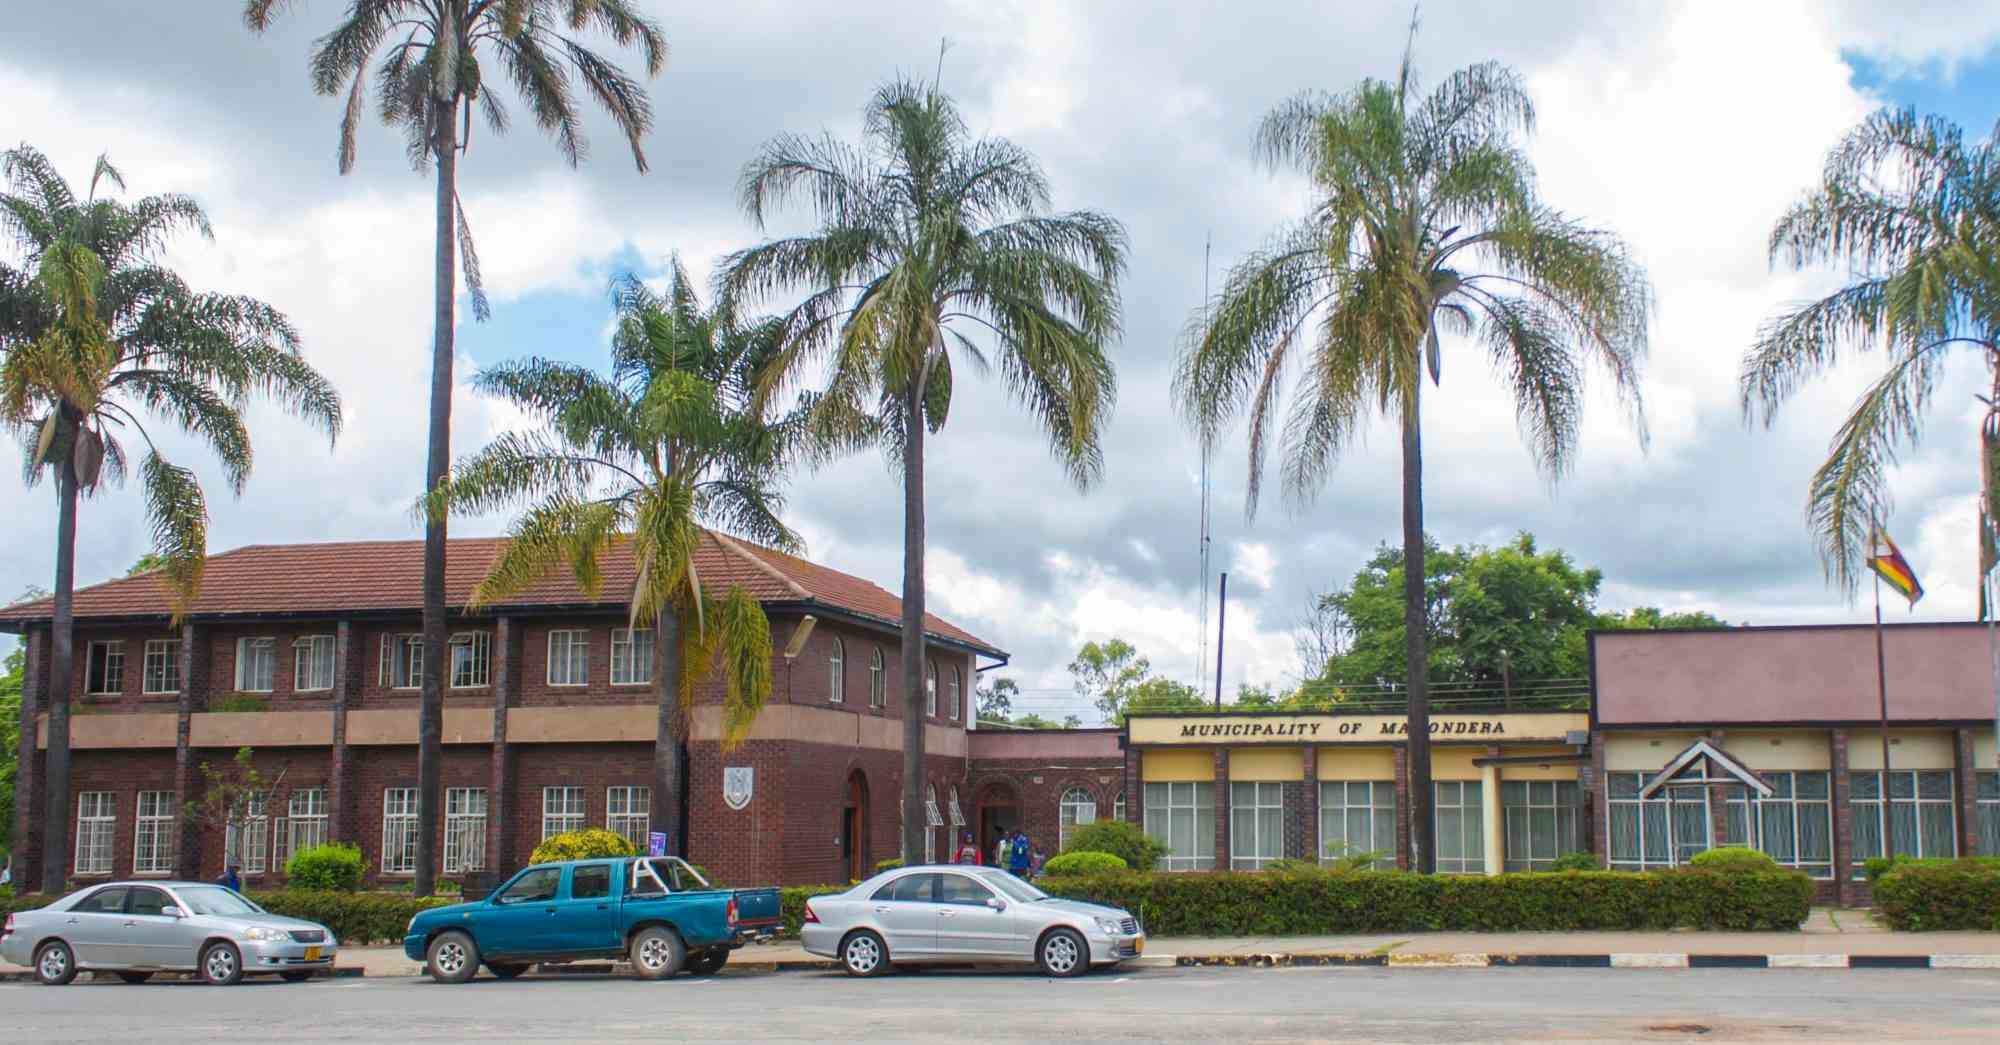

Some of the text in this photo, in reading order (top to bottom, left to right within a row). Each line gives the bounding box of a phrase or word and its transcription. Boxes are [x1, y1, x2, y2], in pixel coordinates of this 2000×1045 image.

[1181, 721, 1505, 736] MUNICIPALITY OF MAONDERA
